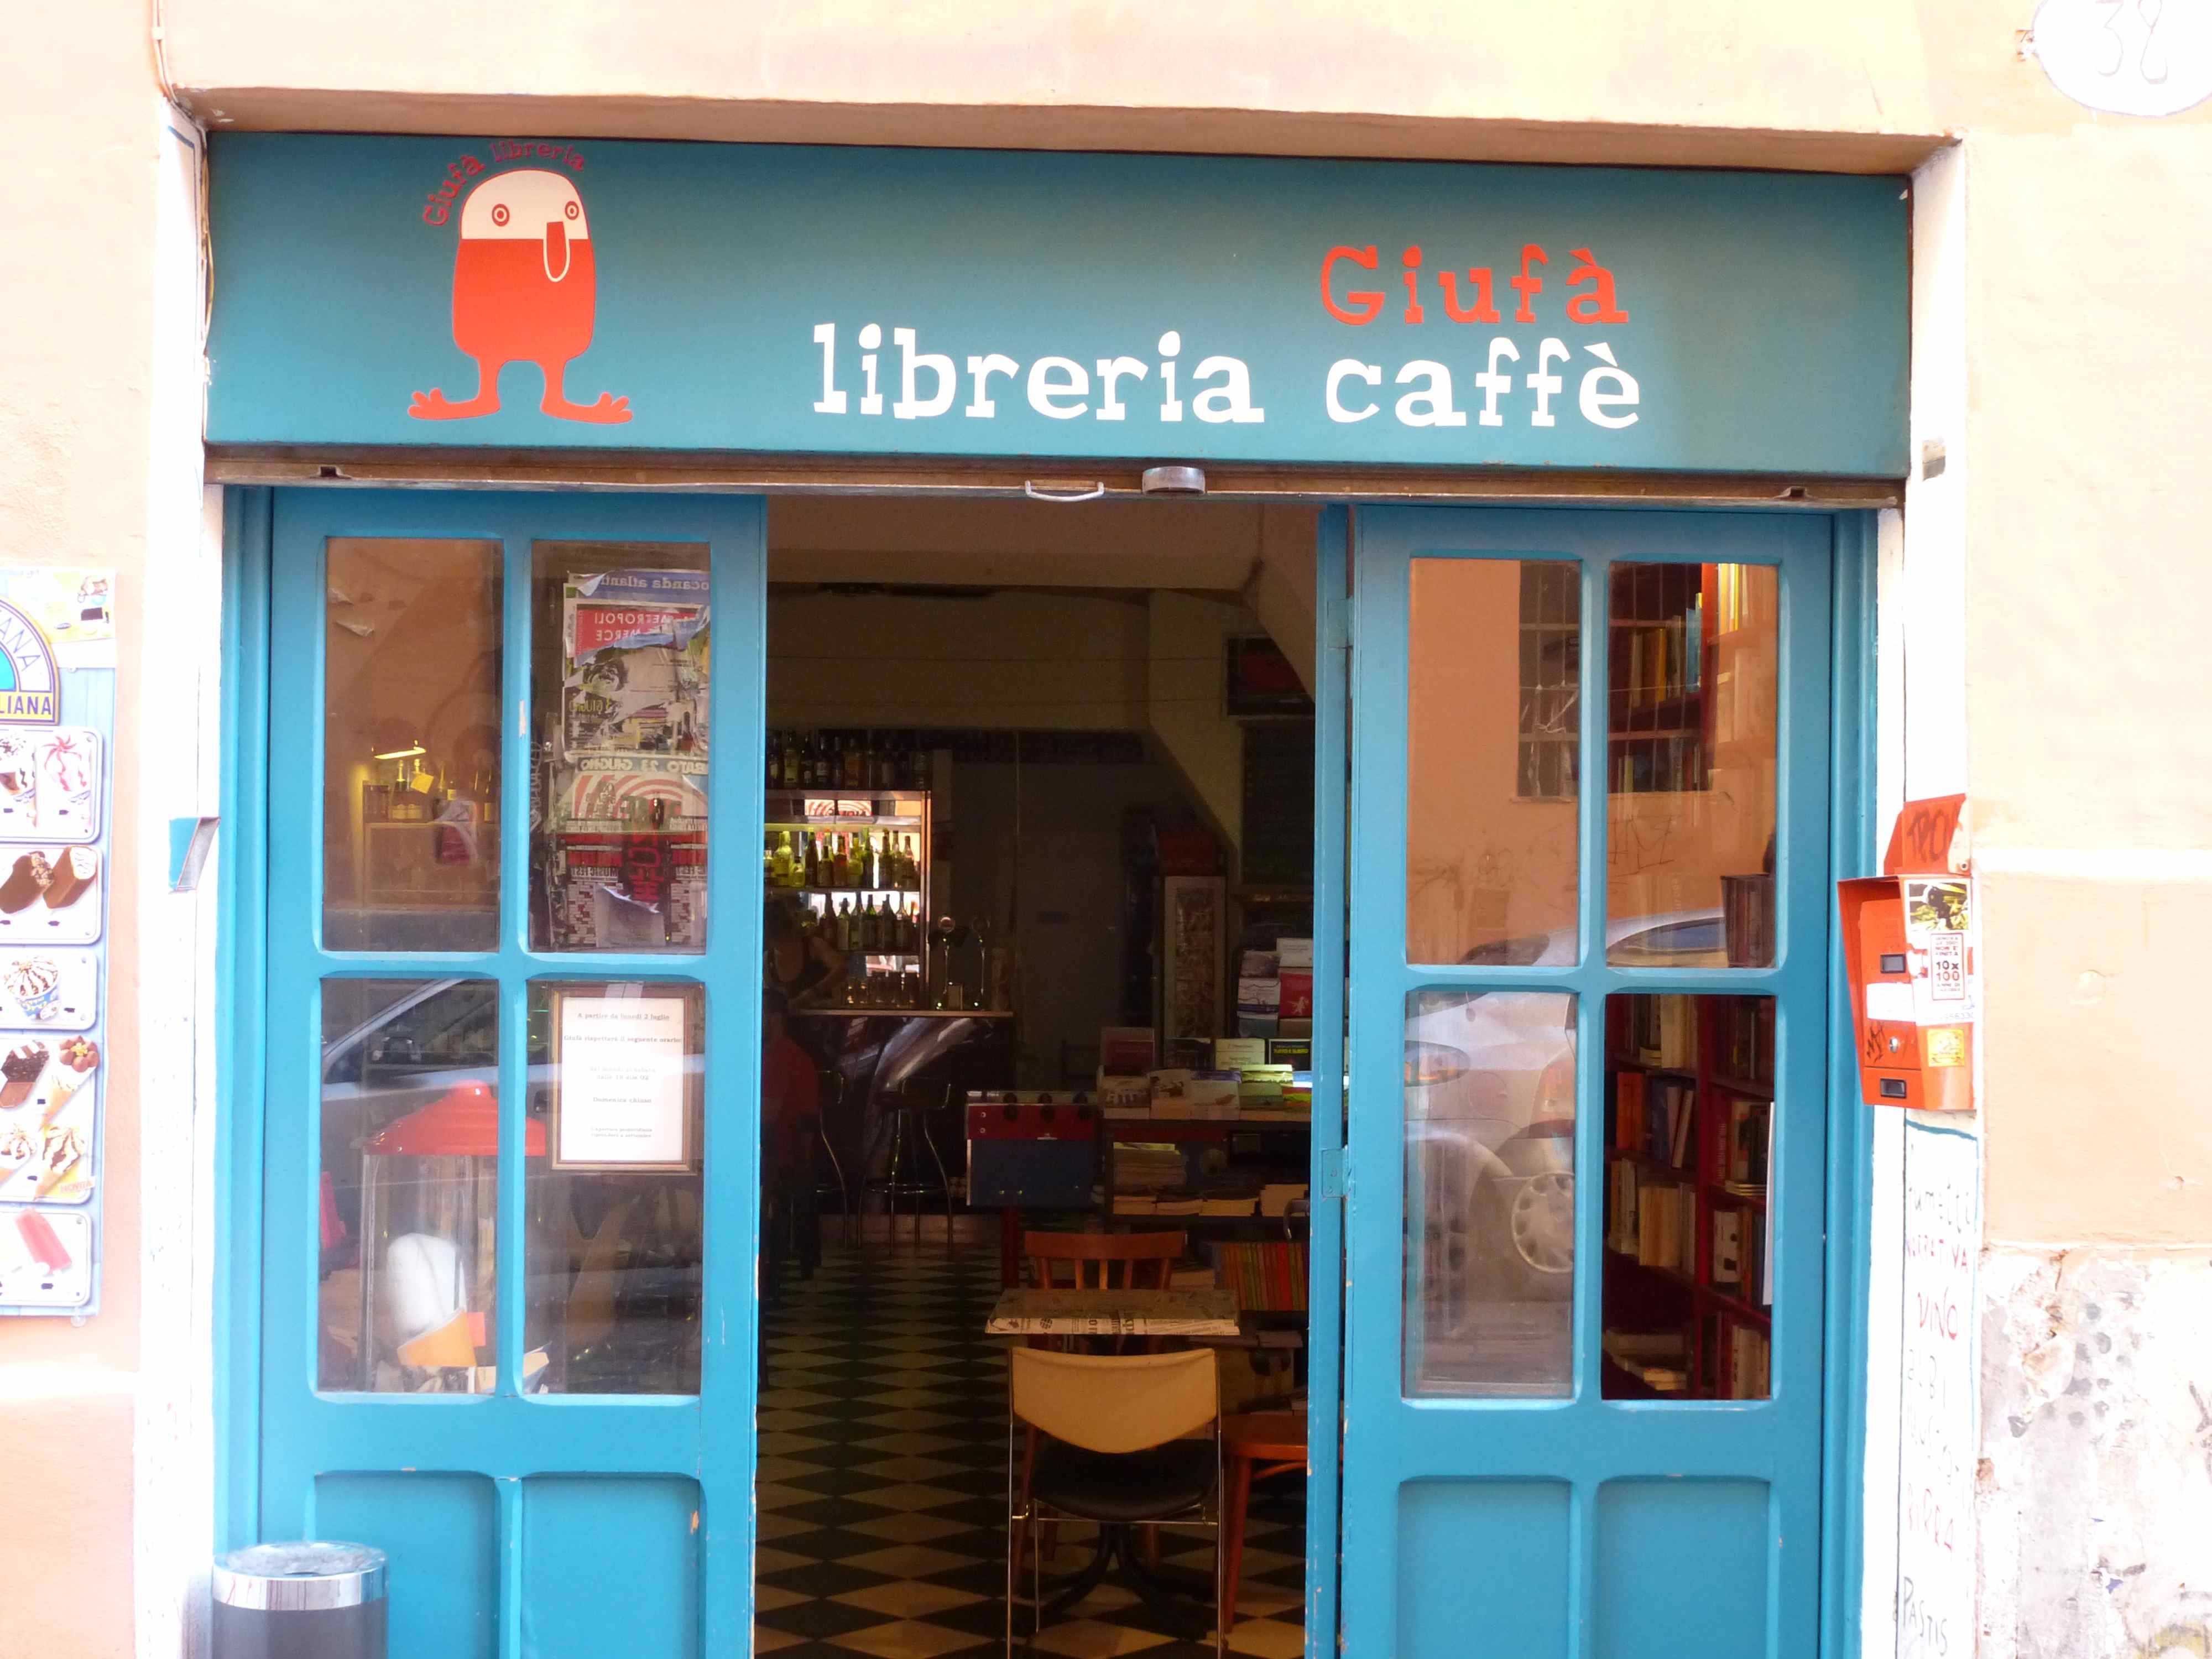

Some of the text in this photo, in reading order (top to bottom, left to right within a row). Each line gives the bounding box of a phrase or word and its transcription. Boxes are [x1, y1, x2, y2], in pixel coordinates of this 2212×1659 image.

[422, 138, 585, 226] Giufà libreria
[1321, 244, 1629, 325] Giufà
[813, 323, 1639, 429] libreria caffè
[1936, 971, 1960, 981] 100
[1917, 1286, 1958, 1341] VINO
[1902, 1576, 1948, 1657] PASTIS
